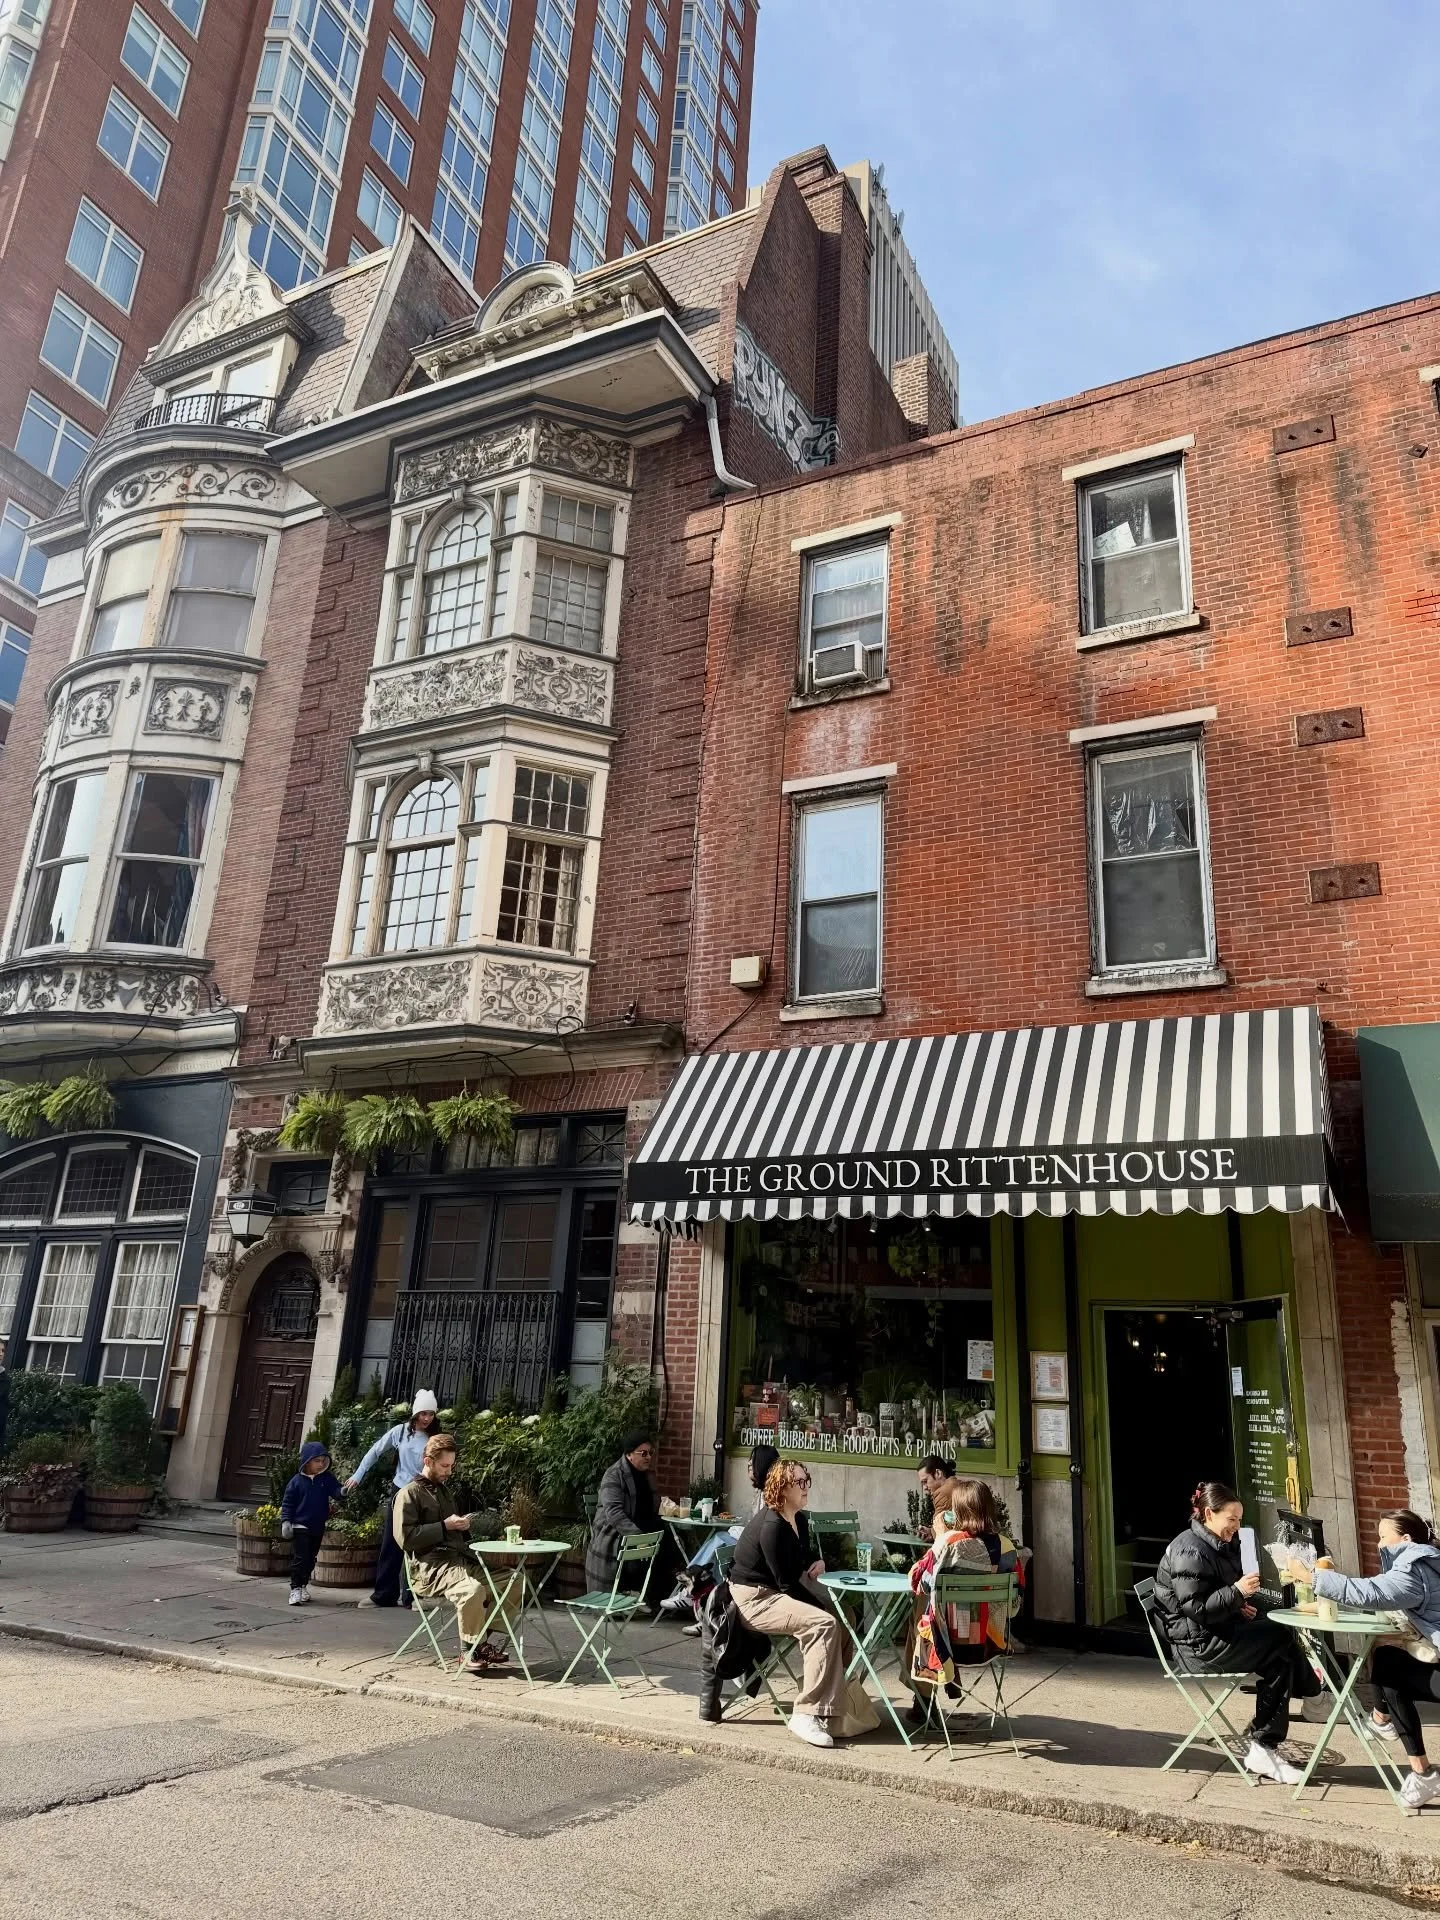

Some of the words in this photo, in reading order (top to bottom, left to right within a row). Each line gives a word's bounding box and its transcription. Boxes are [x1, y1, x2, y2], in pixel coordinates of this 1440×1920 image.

[685, 1165, 752, 1194] THE
[759, 1158, 921, 1192] GROUND
[929, 1148, 1238, 1188] RITTENHOUSE
[740, 1427, 775, 1447] COFFEE
[779, 1430, 816, 1450] BUBBLE
[818, 1433, 838, 1453] TEA
[843, 1434, 868, 1455] FOOD
[871, 1436, 900, 1457] GIFTS
[904, 1439, 913, 1457] &
[916, 1438, 957, 1460] PLANTS
